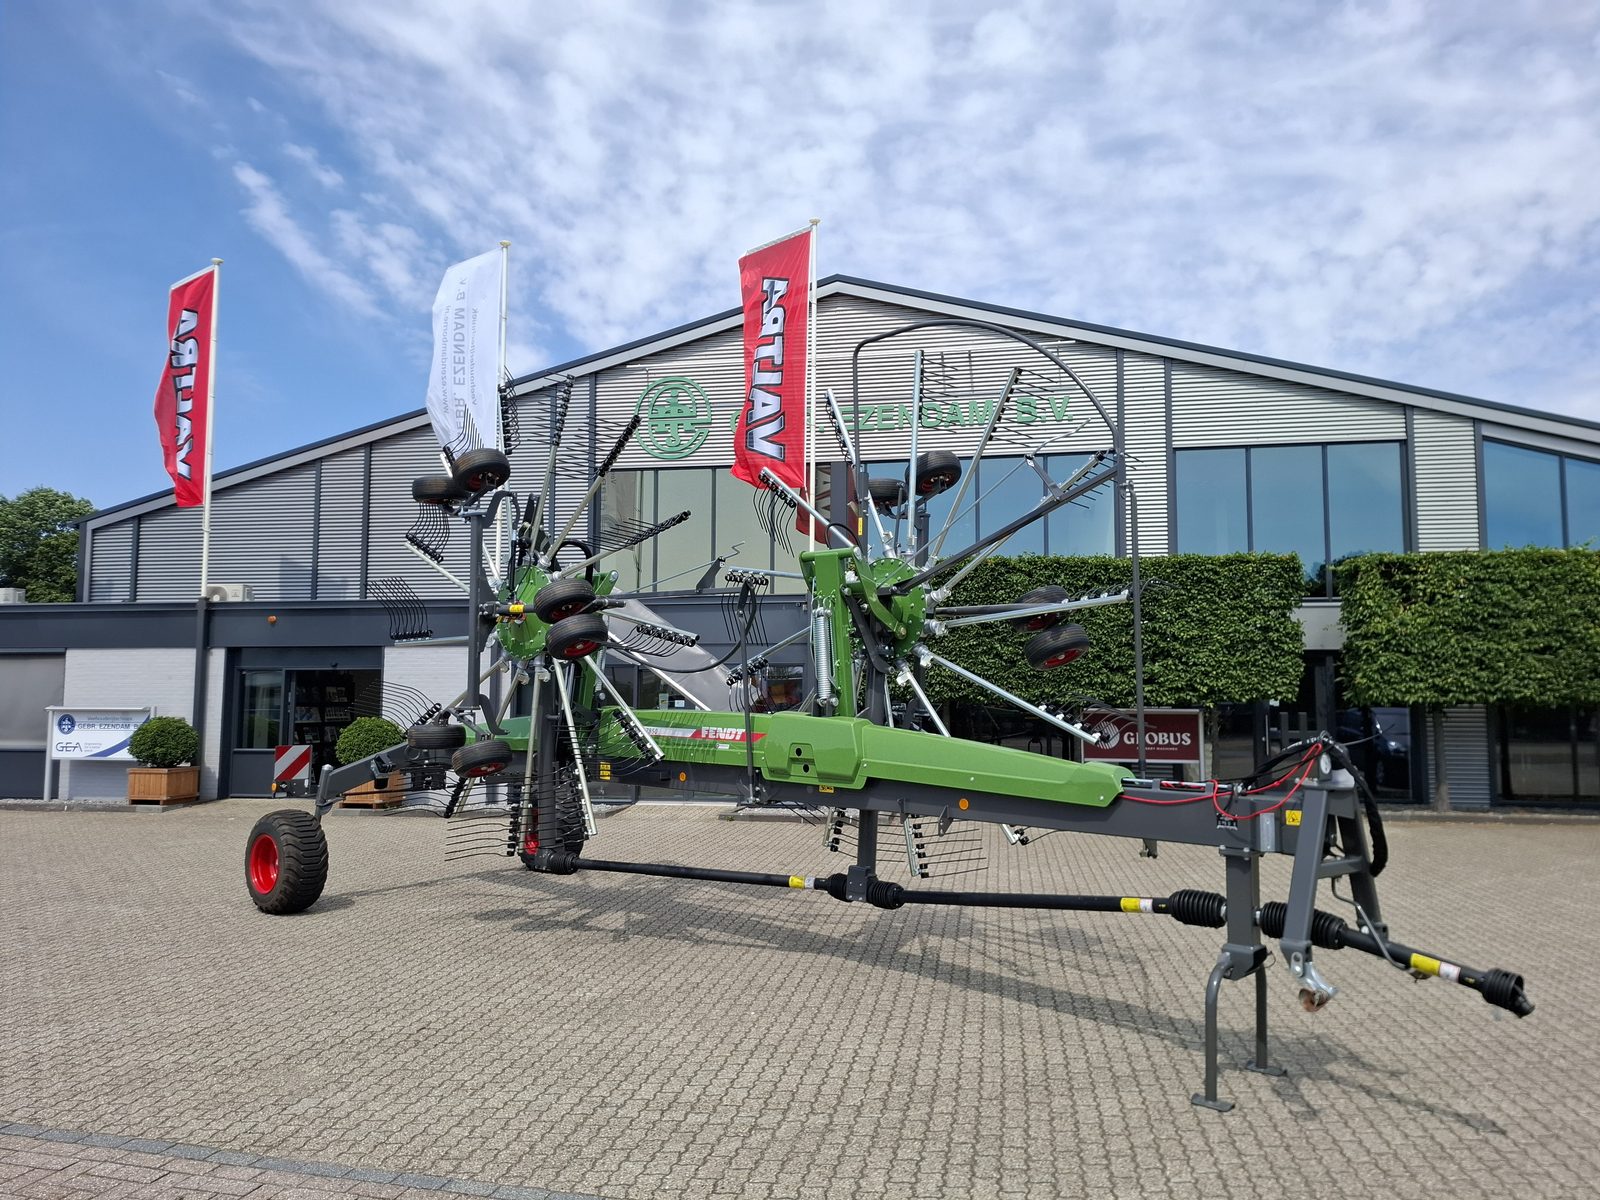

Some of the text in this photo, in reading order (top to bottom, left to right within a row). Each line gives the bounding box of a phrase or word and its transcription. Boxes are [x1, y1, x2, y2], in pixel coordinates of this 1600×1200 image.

[837, 399, 994, 432] EZENDAM
[1016, 395, 1073, 424] B.V.
[701, 726, 746, 740] FENDT
[56, 741, 82, 753] GEA
